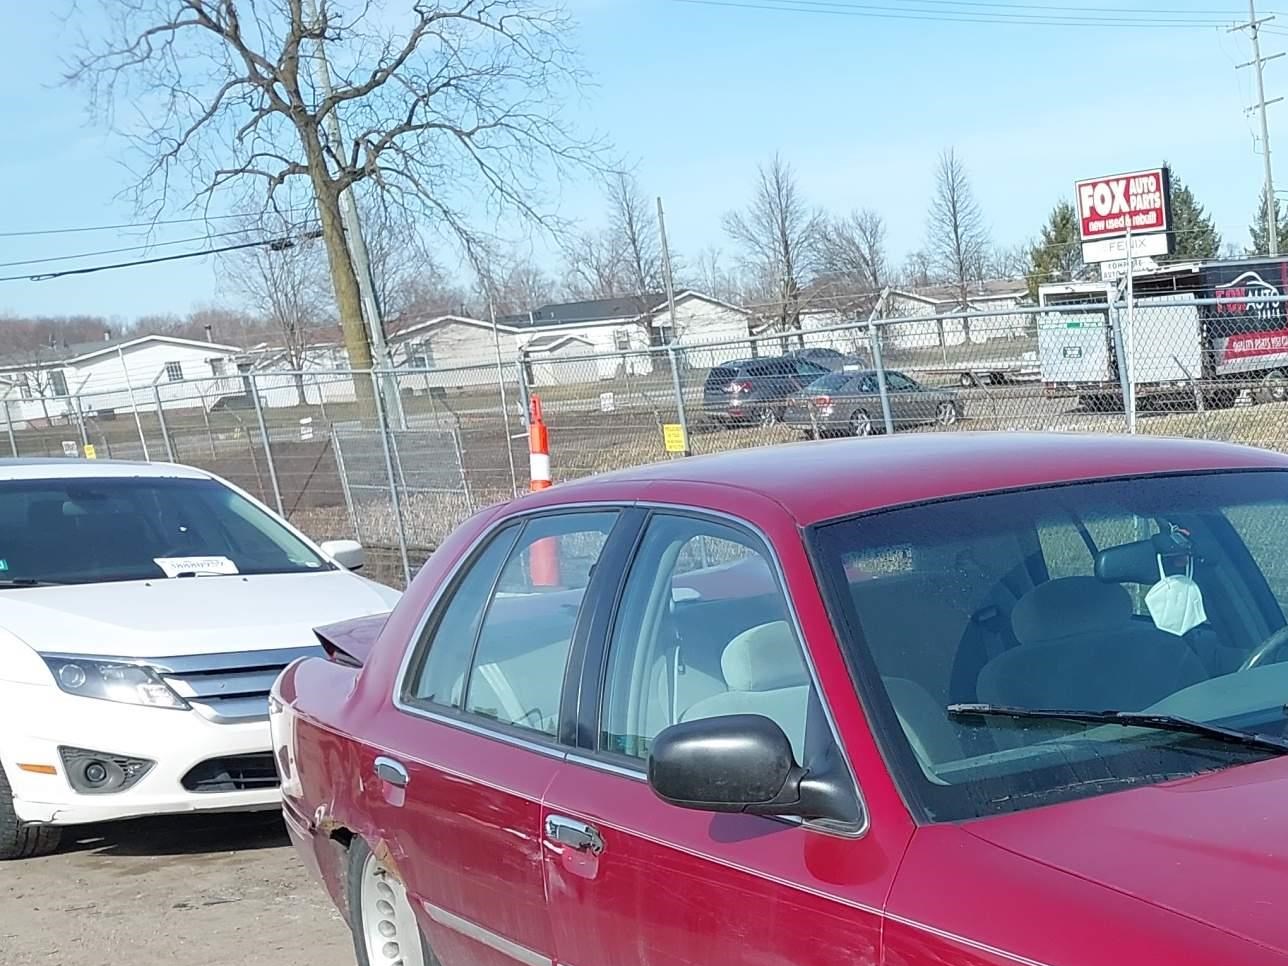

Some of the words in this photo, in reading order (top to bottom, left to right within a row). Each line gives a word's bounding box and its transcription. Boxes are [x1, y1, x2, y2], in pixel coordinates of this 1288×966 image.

[1129, 175, 1156, 194] AUTO
[1080, 180, 1130, 219] FOX
[1130, 192, 1160, 210] PARTS
[1088, 220, 1105, 232] new
[1106, 216, 1124, 230] used
[1132, 210, 1157, 226] rebuilt
[1246, 288, 1280, 310] AUTO
